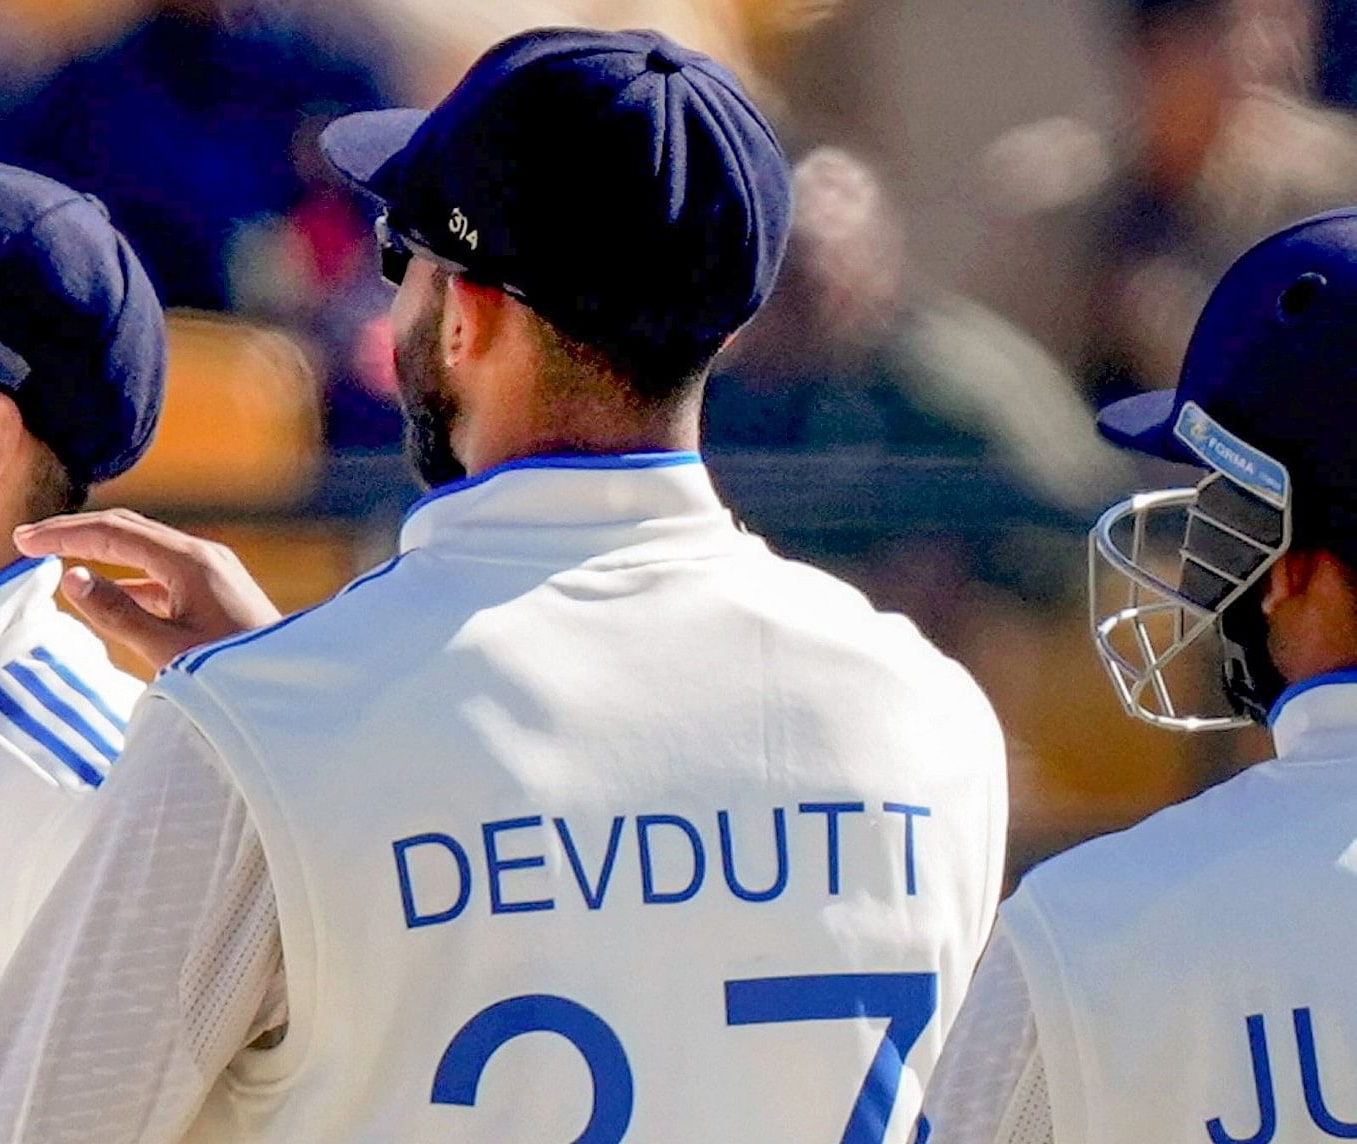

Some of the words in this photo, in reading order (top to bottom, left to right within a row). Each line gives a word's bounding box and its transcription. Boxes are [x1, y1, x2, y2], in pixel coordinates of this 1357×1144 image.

[448, 206, 479, 251] 314
[1207, 436, 1255, 476] FORMA
[391, 801, 932, 929] DEVDUTT
